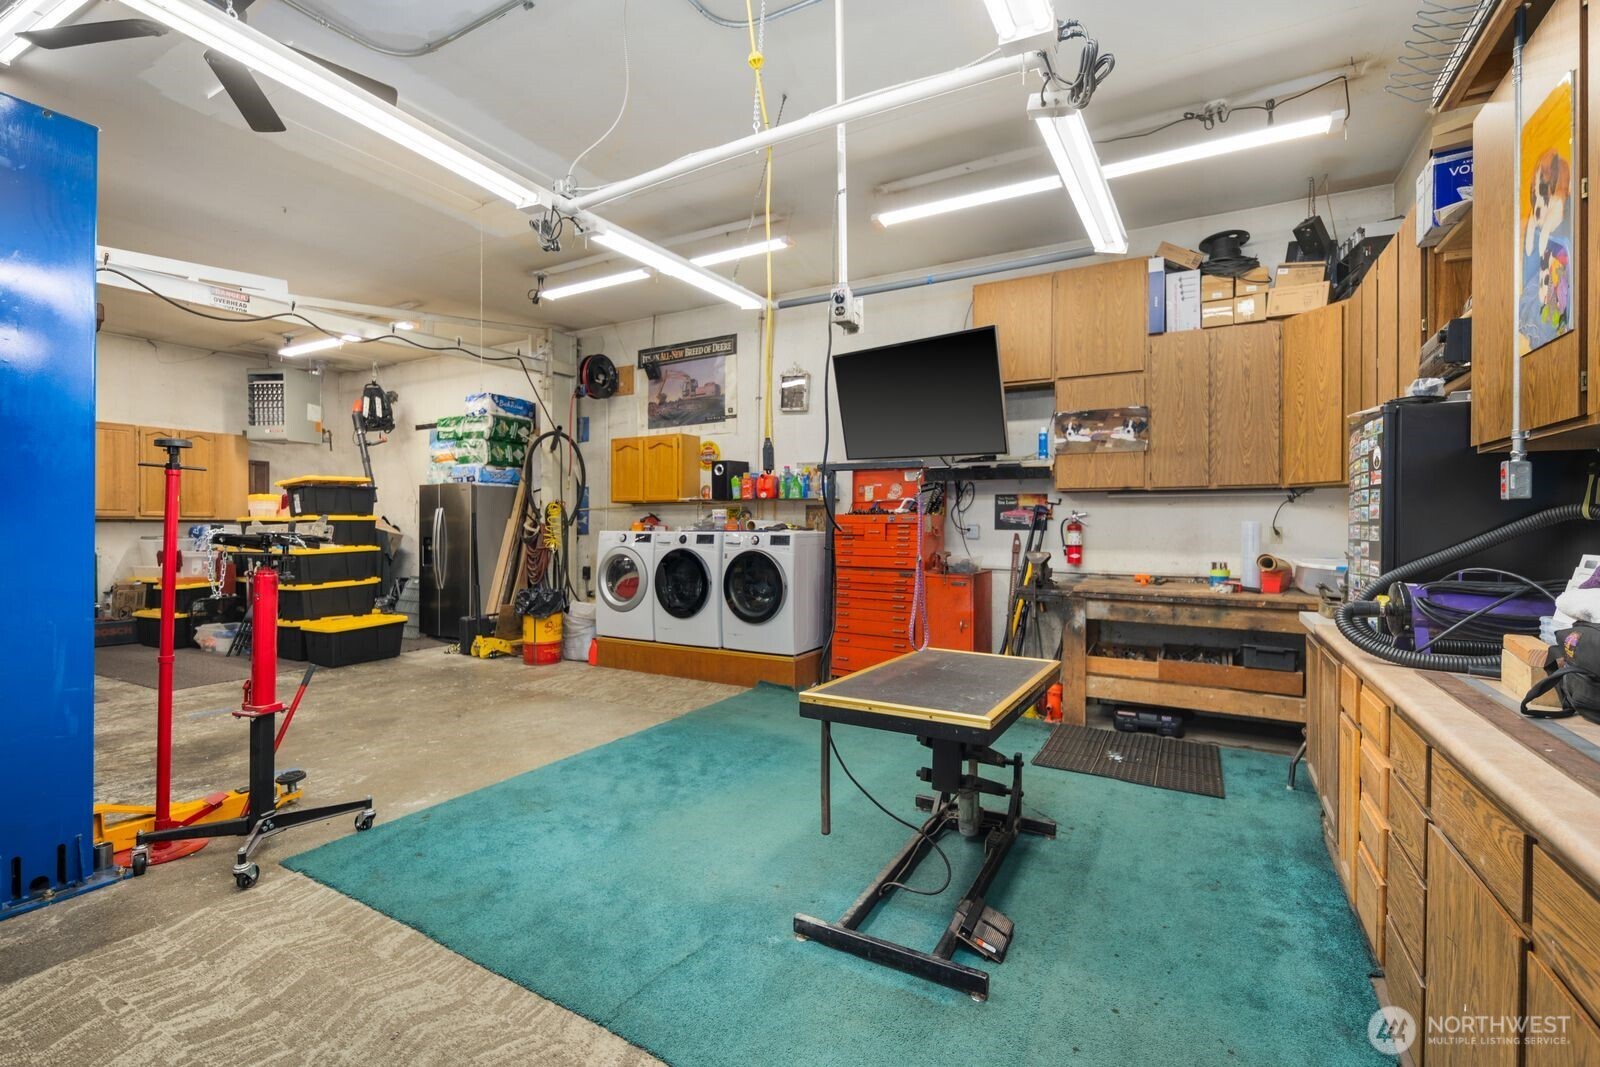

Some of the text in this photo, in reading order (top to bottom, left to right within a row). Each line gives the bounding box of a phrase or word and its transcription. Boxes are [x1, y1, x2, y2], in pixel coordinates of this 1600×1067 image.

[213, 297, 247, 309] OVERHEAD
[660, 349, 685, 361] ALL-NEW
[685, 347, 703, 357] BREED
[704, 345, 711, 354] OF
[712, 342, 732, 352] DEERE
